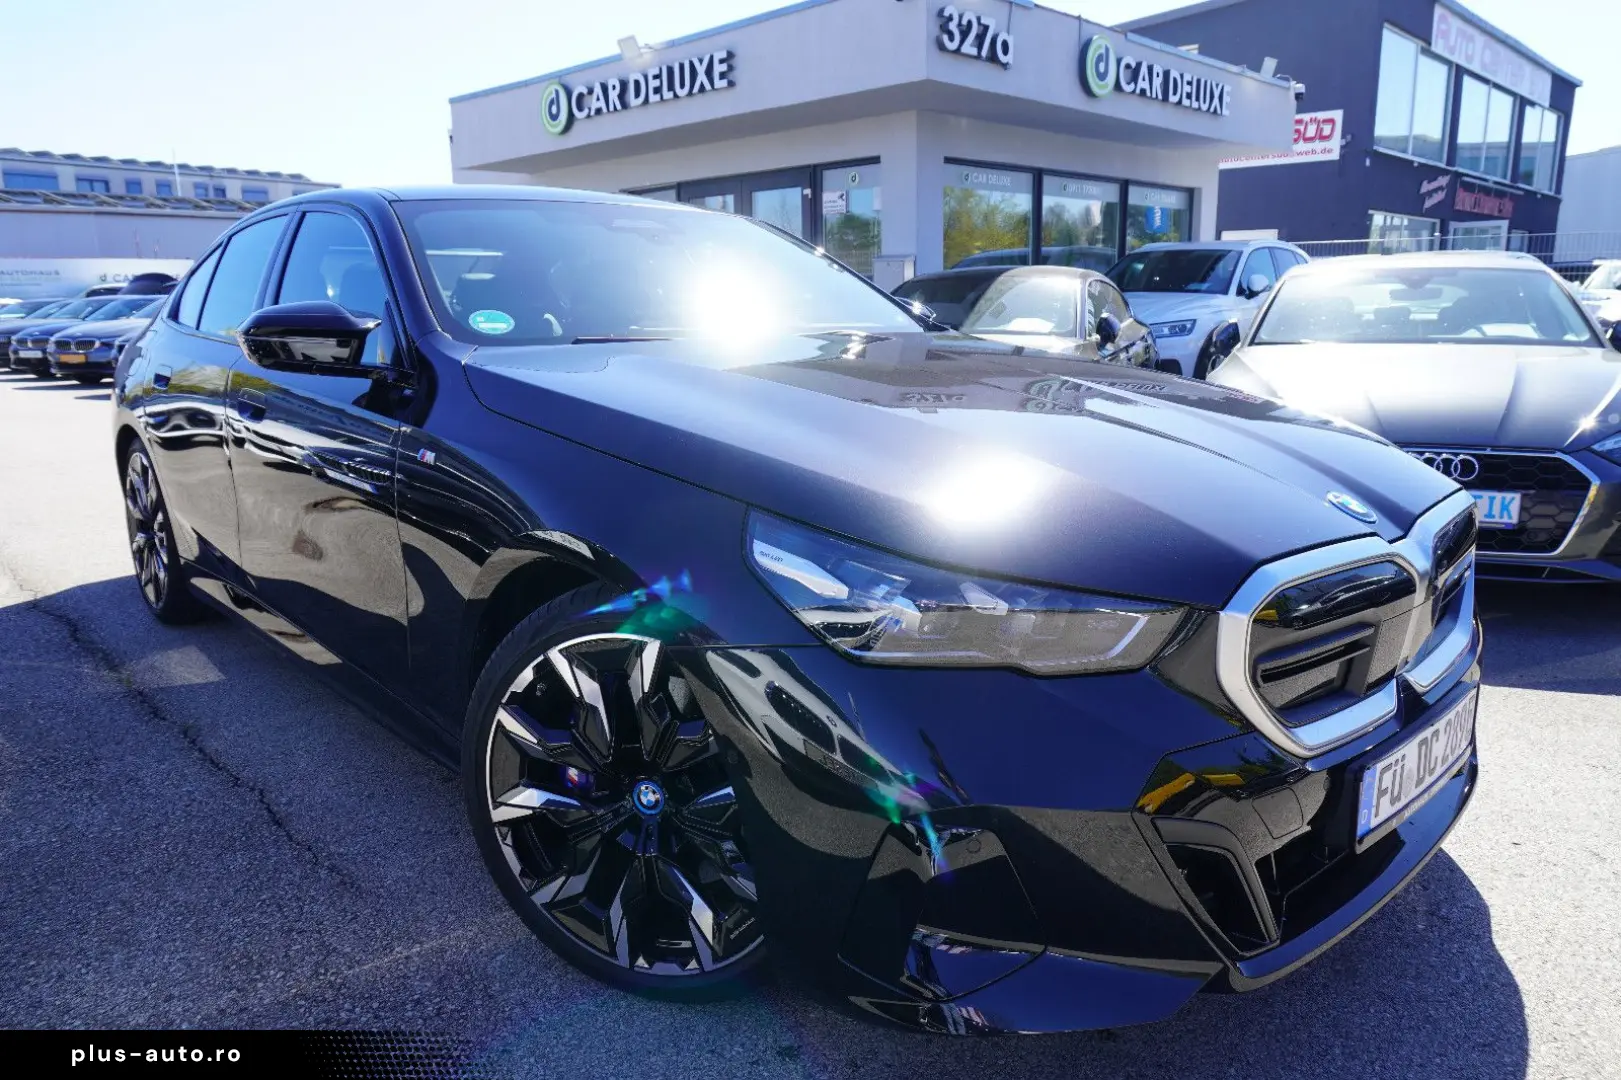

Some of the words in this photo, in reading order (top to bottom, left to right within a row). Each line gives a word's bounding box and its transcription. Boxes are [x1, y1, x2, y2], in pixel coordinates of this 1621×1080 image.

[941, 5, 1014, 65] 327a
[571, 77, 622, 120] CAR
[628, 49, 729, 108] DELUXE
[1118, 55, 1164, 101] CAR
[1167, 68, 1232, 116] DELUXE
[1374, 754, 1406, 819] FÜ
[1415, 728, 1440, 789] DC
